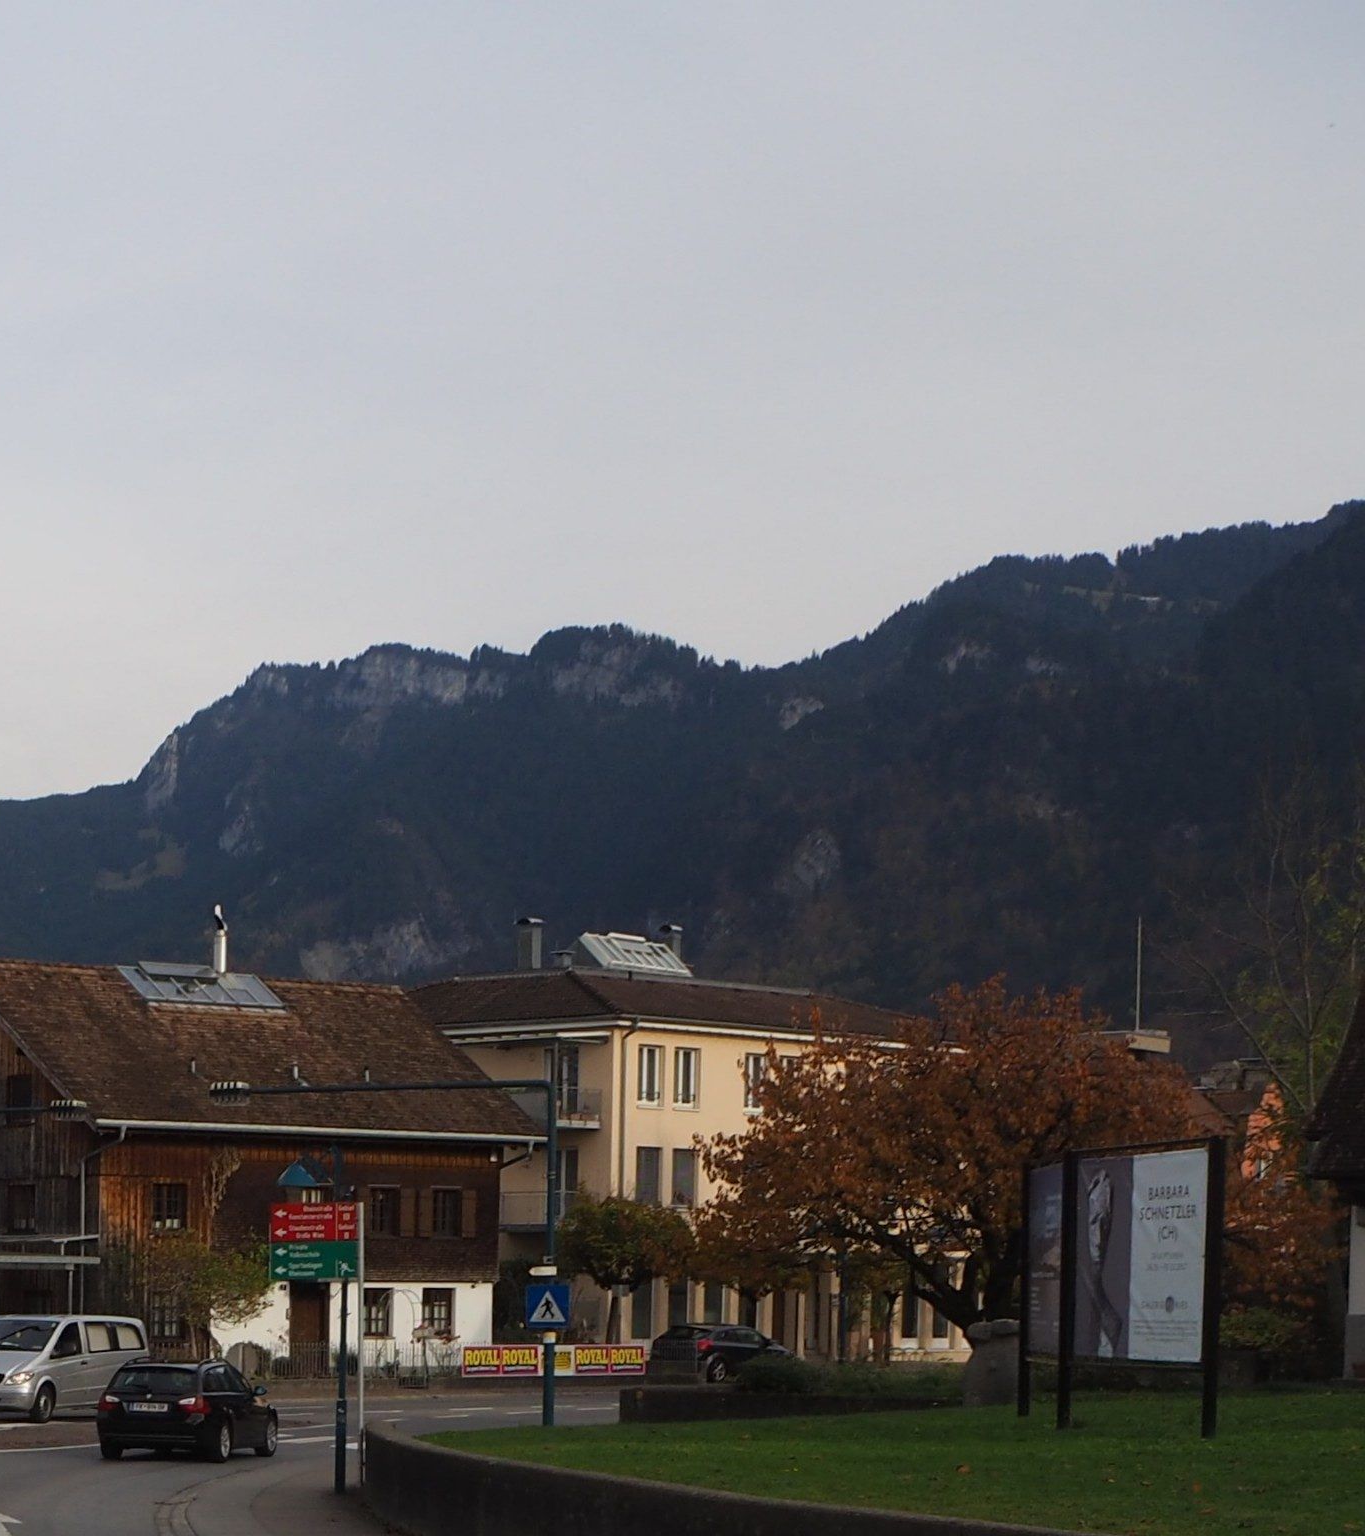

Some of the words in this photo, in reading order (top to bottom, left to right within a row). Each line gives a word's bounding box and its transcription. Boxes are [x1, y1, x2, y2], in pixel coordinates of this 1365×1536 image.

[1148, 1185, 1190, 1201] BARBARA
[1139, 1204, 1197, 1221] SCHNETZLER
[464, 1349, 501, 1366] ROYAL
[502, 1349, 538, 1366] ROYAL
[575, 1349, 609, 1365] ROYAL
[610, 1349, 644, 1365] ROYAL
